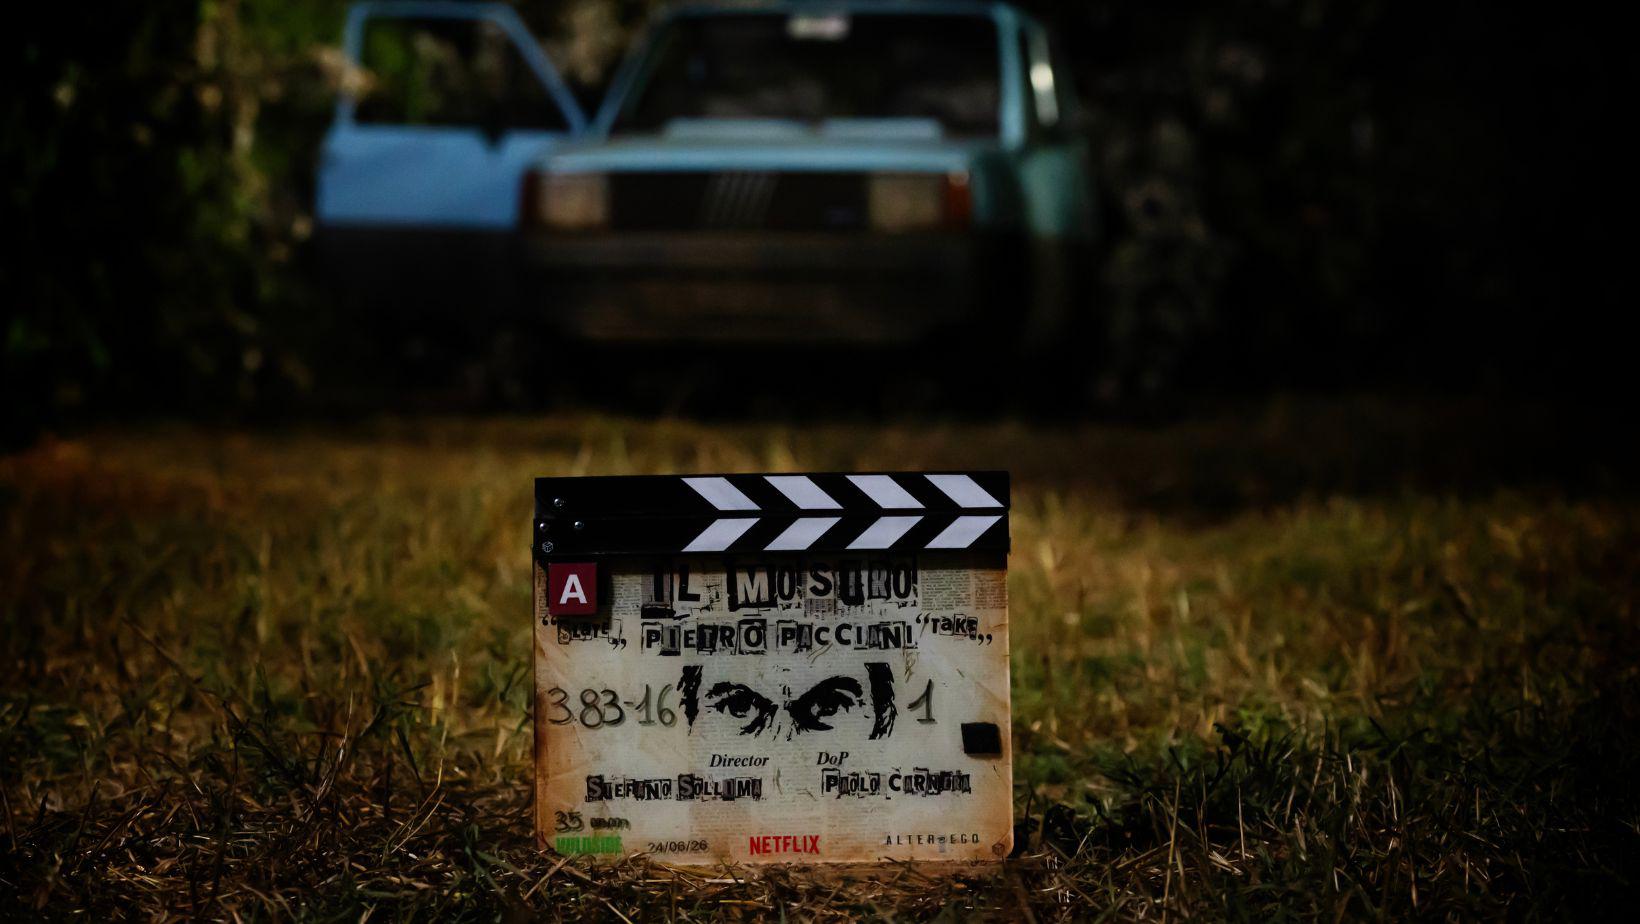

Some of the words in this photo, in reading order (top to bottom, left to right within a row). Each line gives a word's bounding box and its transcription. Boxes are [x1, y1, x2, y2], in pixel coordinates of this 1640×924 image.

[559, 574, 588, 604] A
[653, 562, 701, 602] IL
[645, 622, 765, 650] PIETRO
[780, 622, 913, 650] PACCIANI
[907, 679, 937, 724] 1
[709, 753, 770, 768] Director
[816, 751, 849, 766] DoP
[823, 770, 881, 796] PAOLO
[648, 839, 709, 853] 24/06/26
[749, 835, 820, 856] NETFLIX
[885, 835, 936, 847] ALTER
[949, 833, 980, 845] EGO
